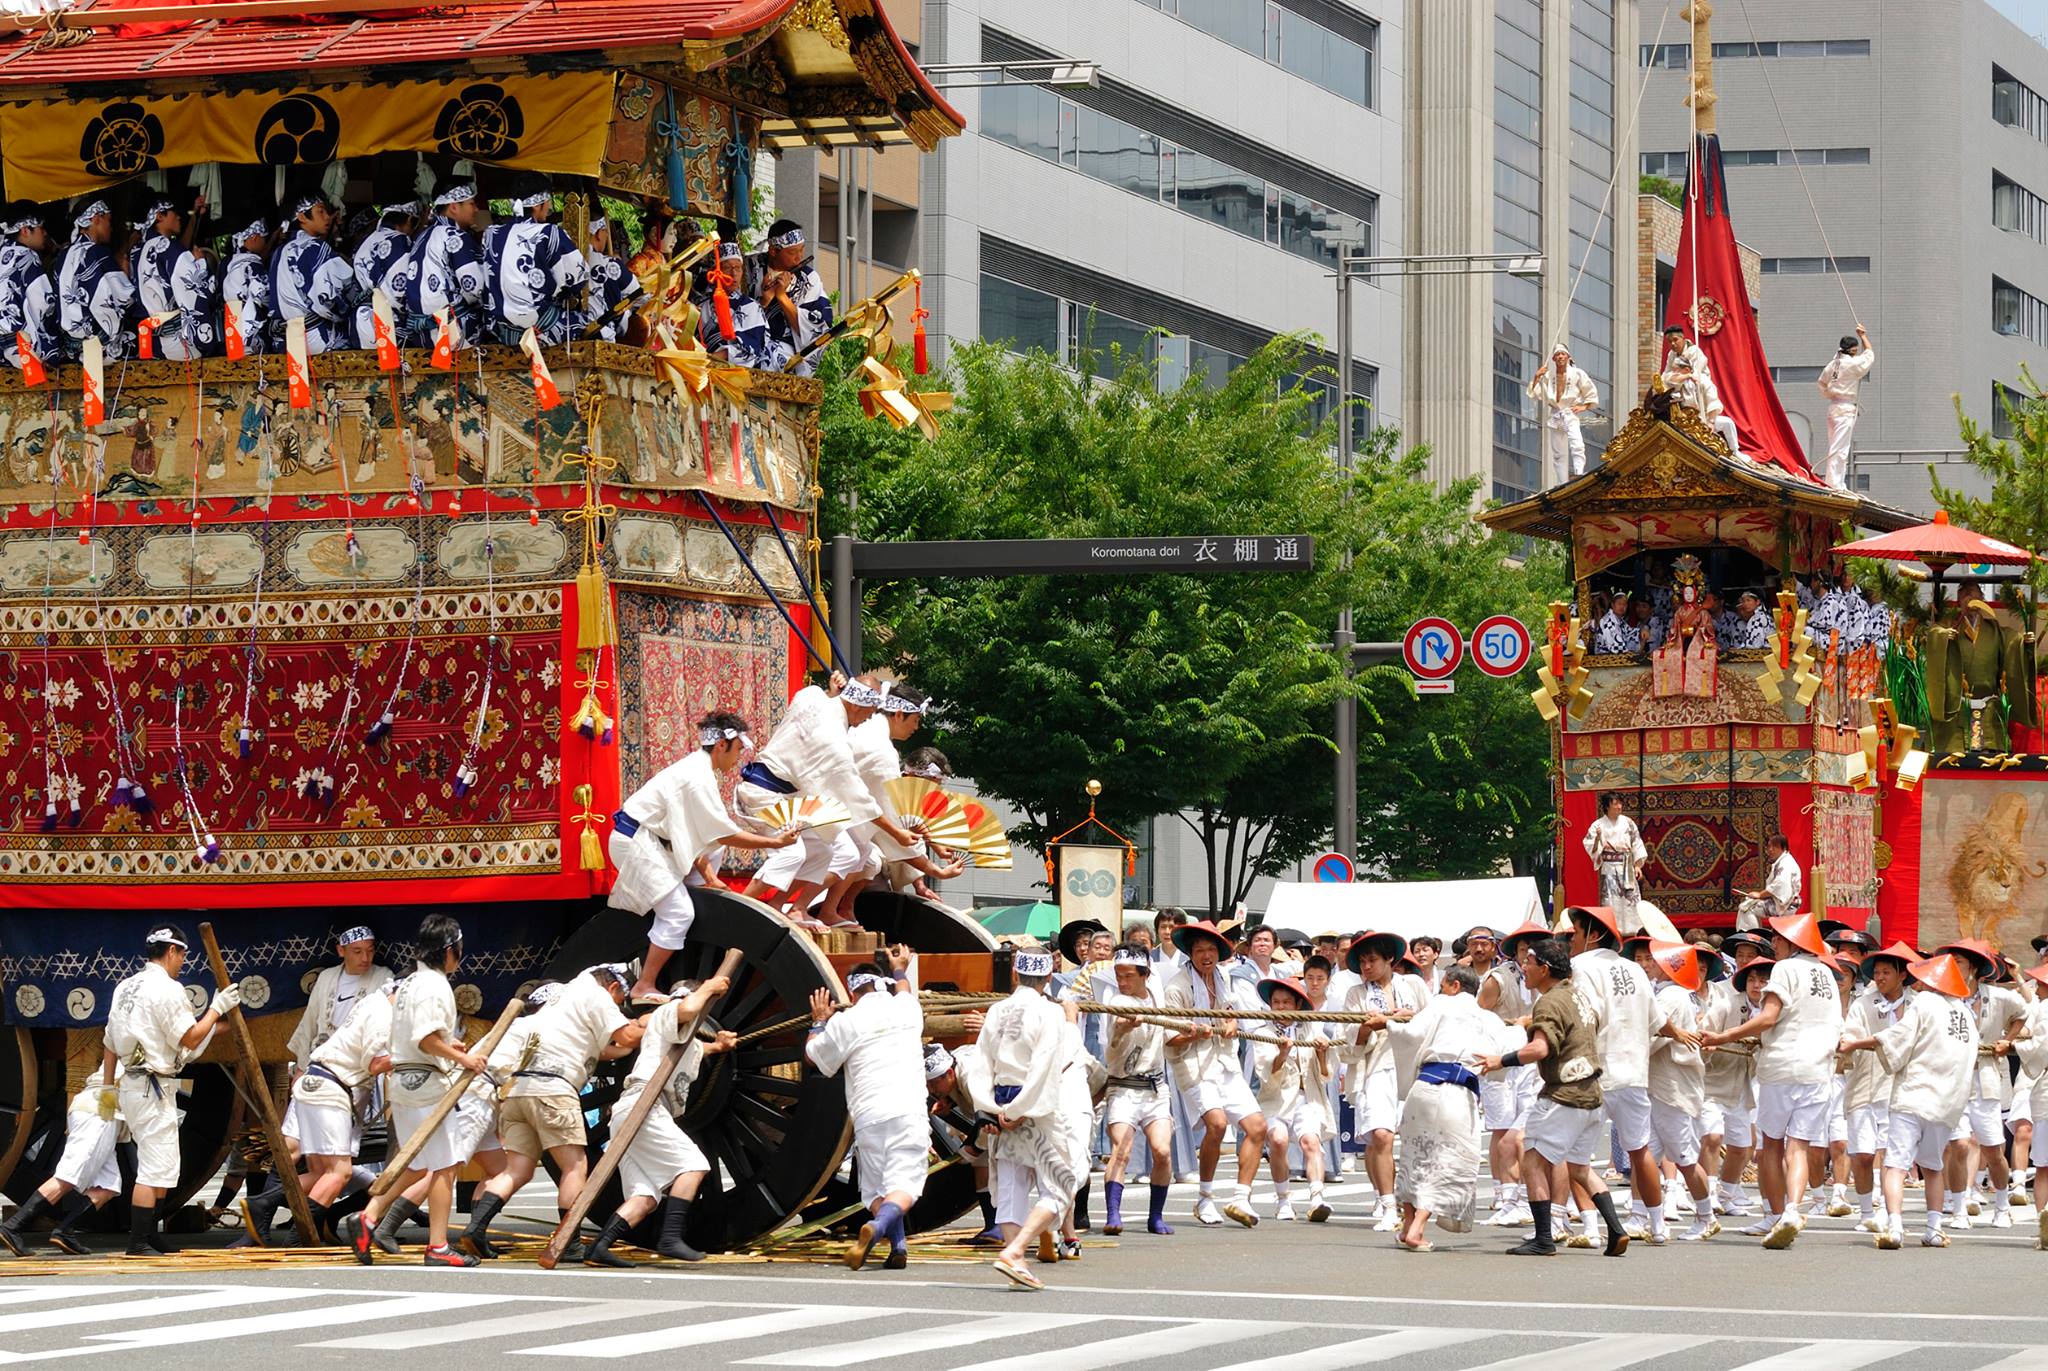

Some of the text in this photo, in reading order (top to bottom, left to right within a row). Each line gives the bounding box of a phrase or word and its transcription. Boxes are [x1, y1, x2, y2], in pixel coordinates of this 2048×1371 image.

[1091, 545, 1180, 558] Koromotana dori
[1193, 538, 1299, 562] 衣棚通
[1485, 633, 1517, 659] 50
